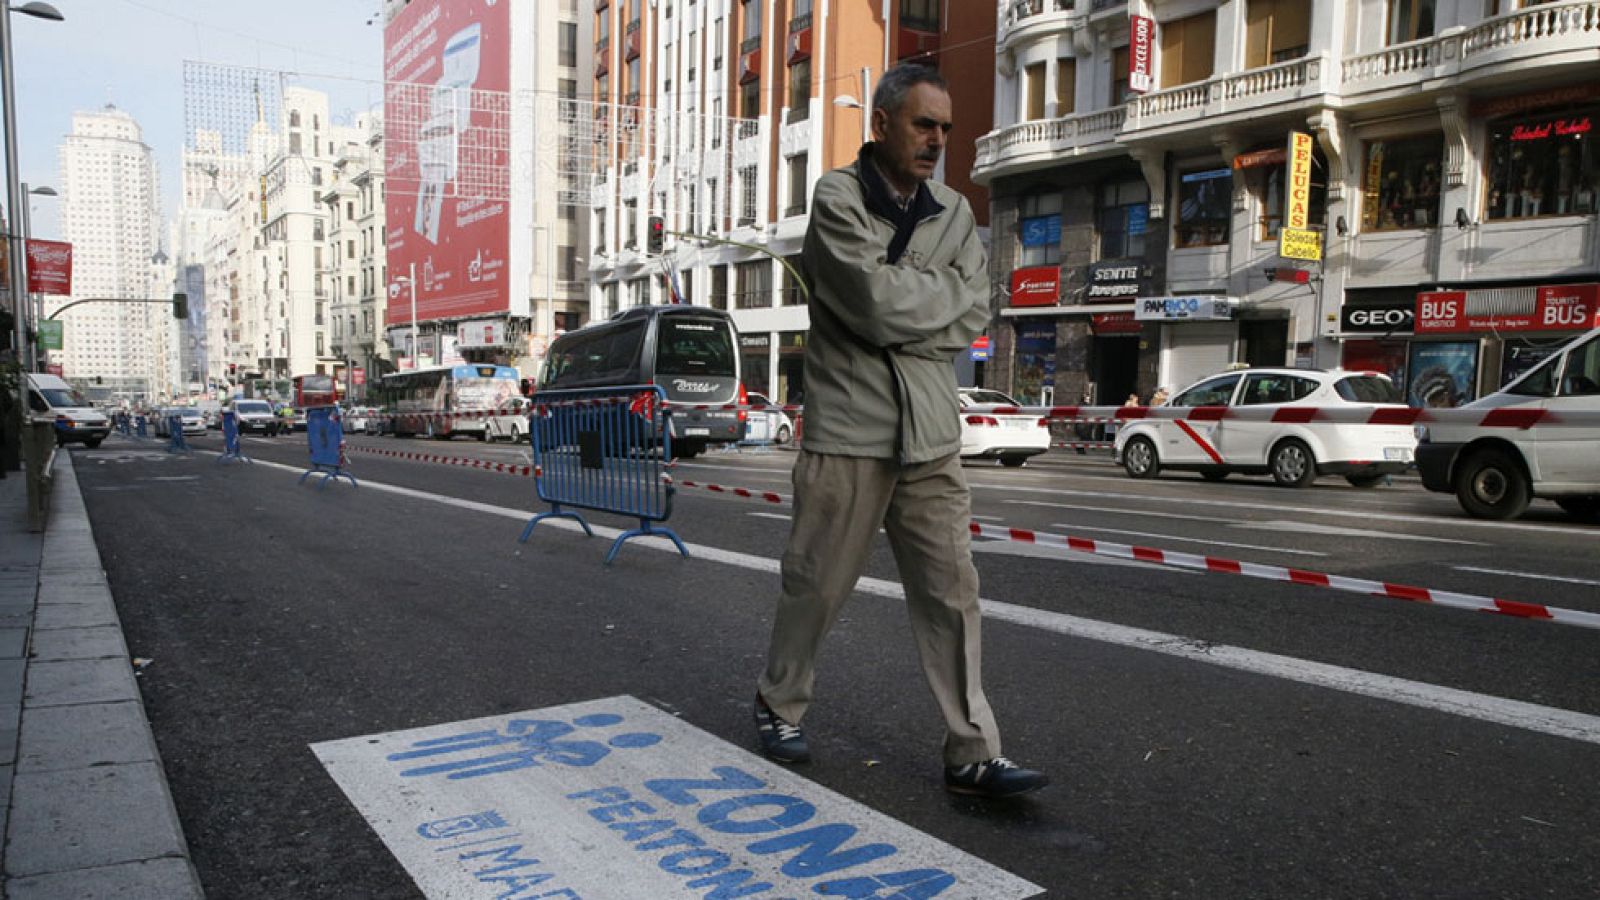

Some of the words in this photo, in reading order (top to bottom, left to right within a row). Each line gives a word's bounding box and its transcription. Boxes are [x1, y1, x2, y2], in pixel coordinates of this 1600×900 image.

[1292, 135, 1309, 227] PELUCAS
[1421, 301, 1457, 319] BUS
[1543, 304, 1588, 325] BUS
[1545, 296, 1580, 305] TOURIST
[566, 786, 800, 900] PEATON
[643, 766, 956, 900] ZONA
